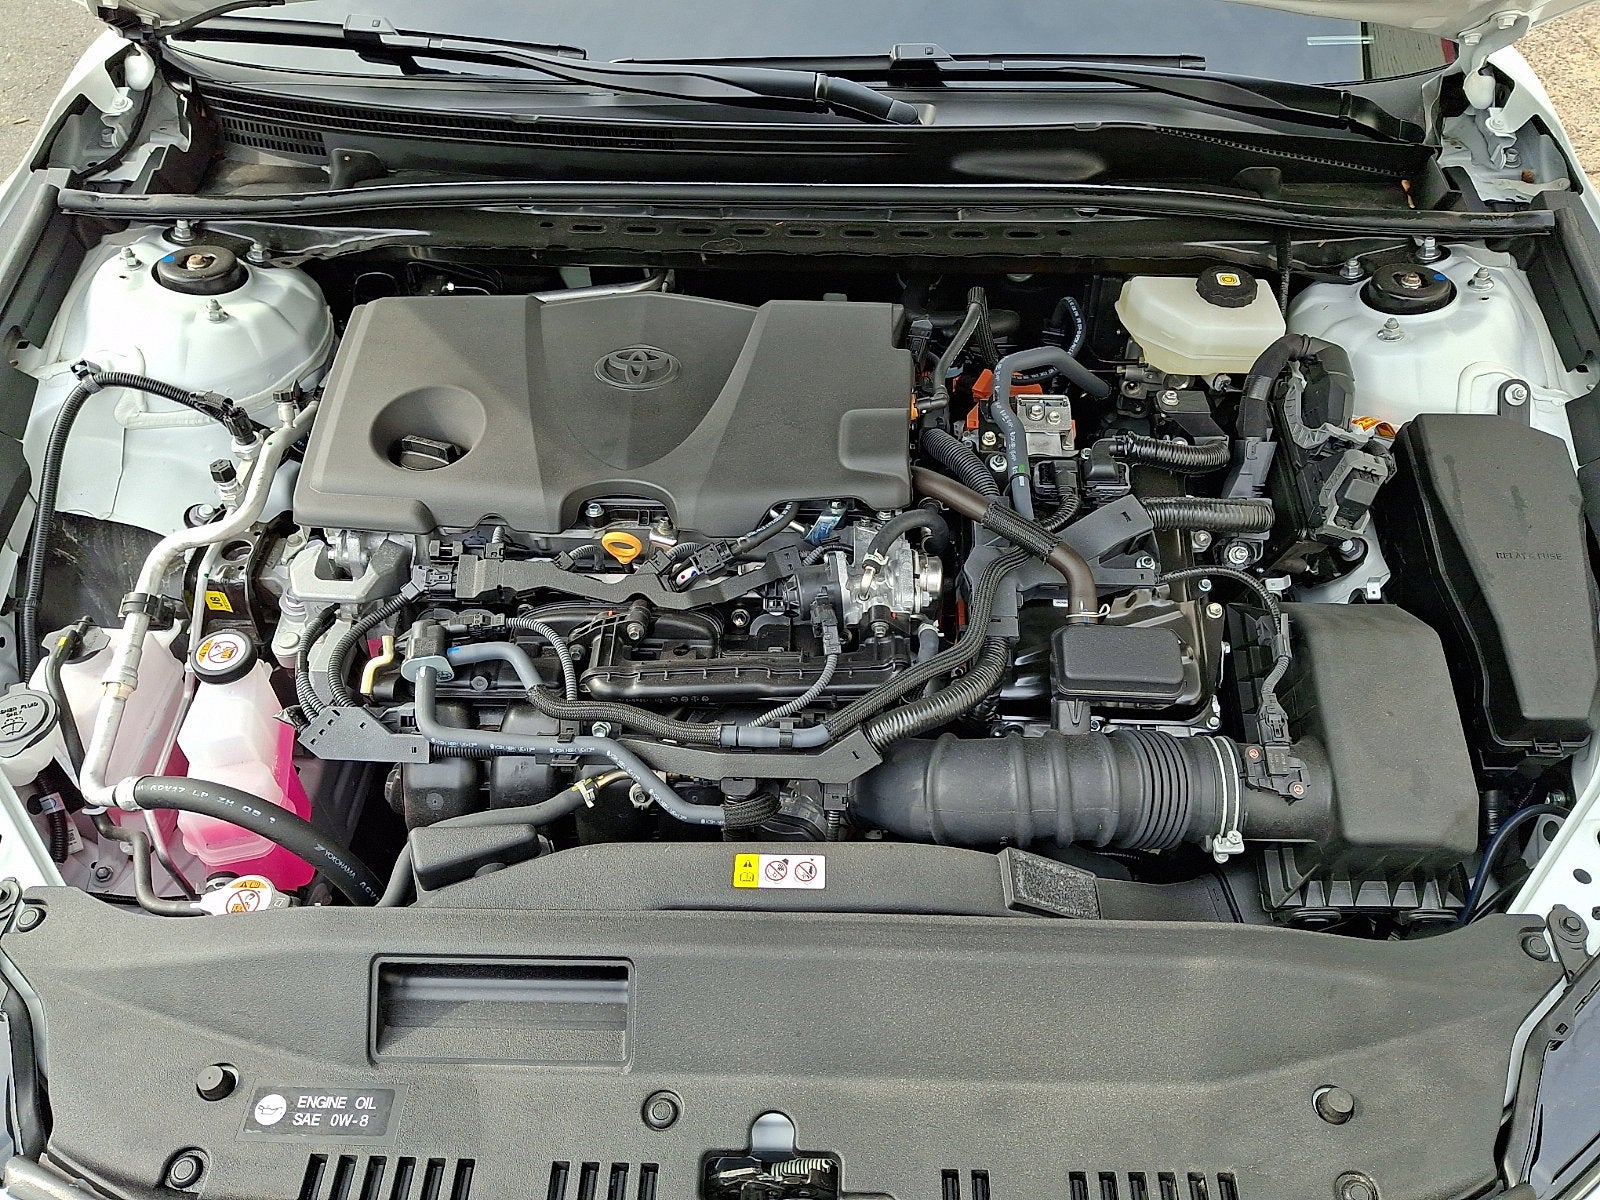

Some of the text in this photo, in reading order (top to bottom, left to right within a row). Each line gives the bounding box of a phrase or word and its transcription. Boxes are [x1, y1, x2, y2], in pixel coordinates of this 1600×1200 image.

[324, 849, 357, 879] YOKOHAMA
[296, 1095, 377, 1110] ENGINE OIL
[292, 1112, 369, 1127] SAE 0W-8
